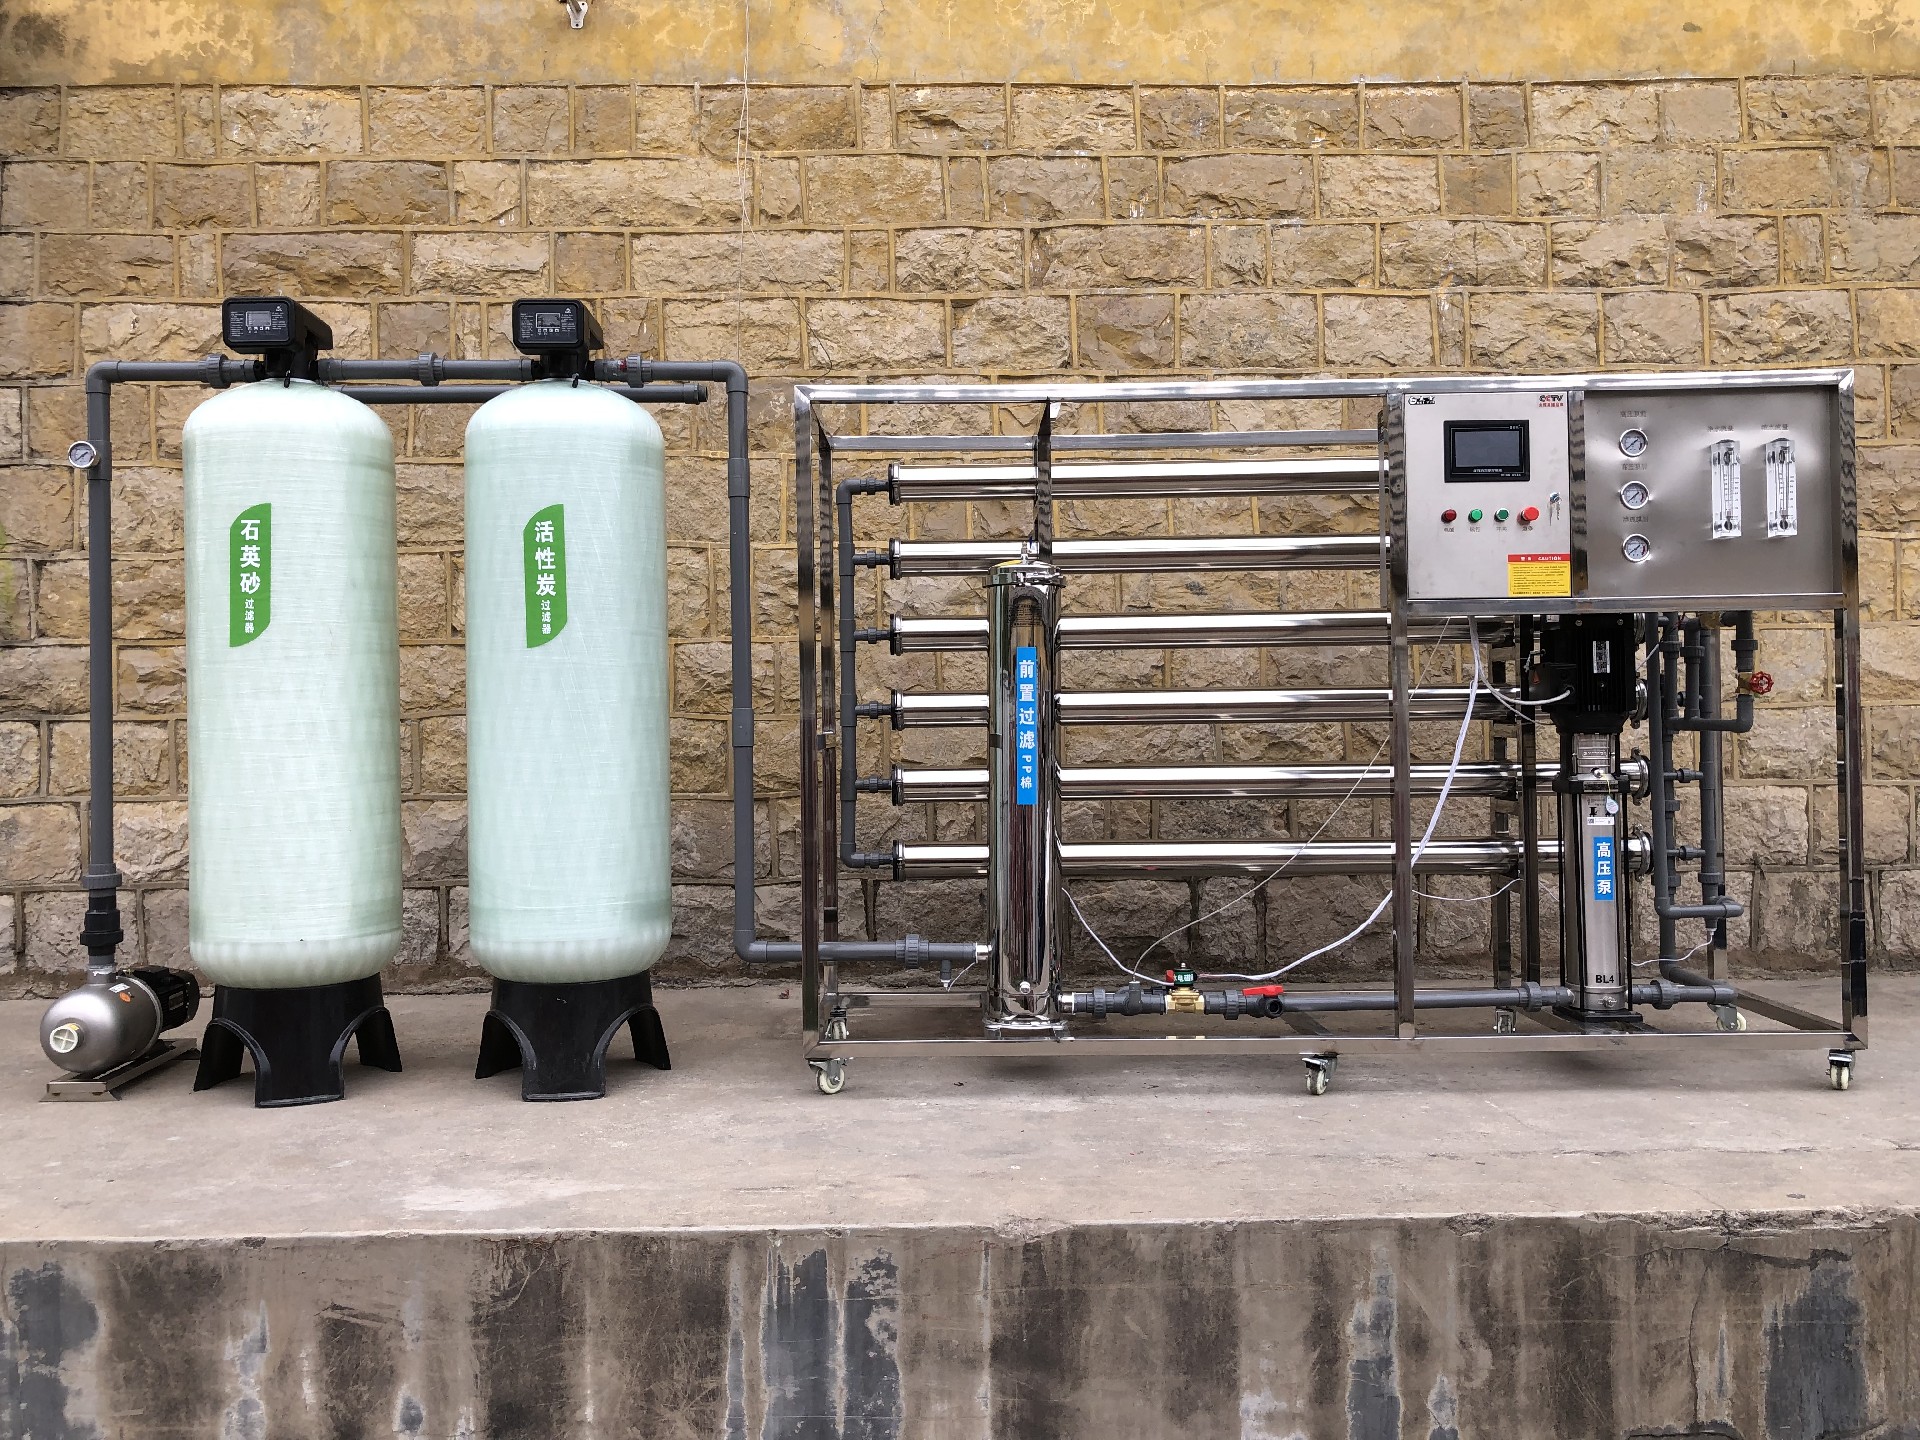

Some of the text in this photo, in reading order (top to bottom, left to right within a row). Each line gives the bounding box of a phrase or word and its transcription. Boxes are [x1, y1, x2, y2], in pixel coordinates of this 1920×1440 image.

[1596, 841, 1612, 895] 高压泵
[1595, 974, 1615, 984] BL4
